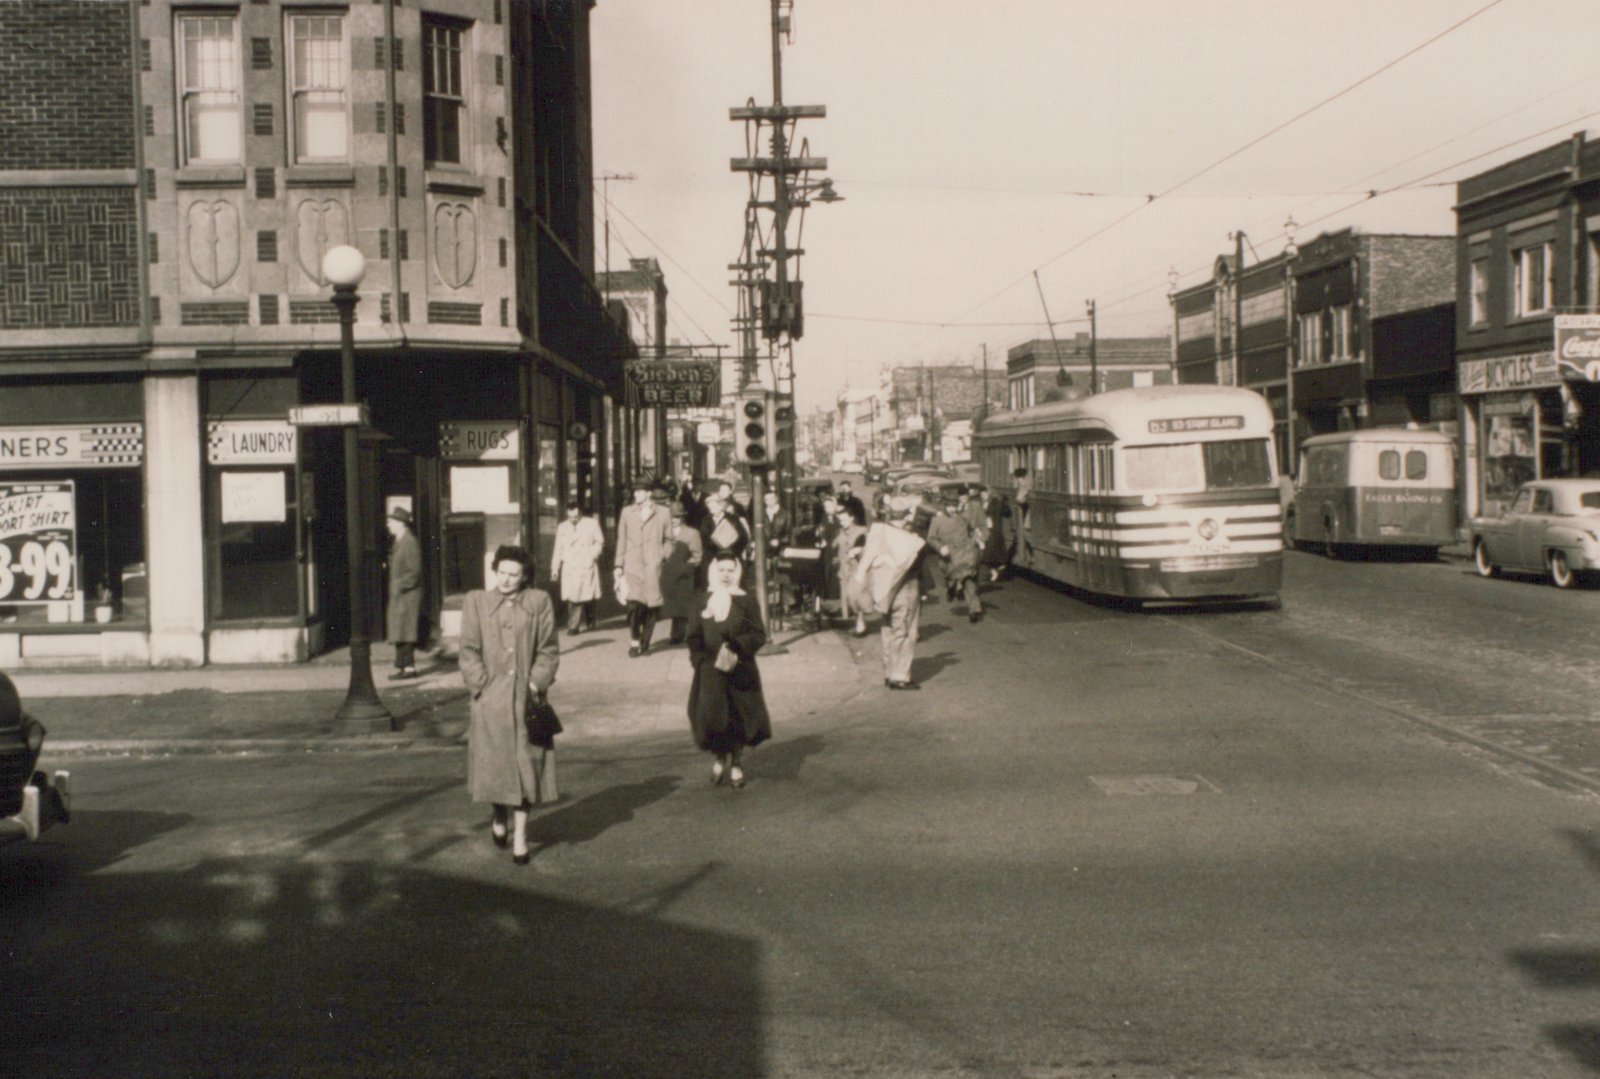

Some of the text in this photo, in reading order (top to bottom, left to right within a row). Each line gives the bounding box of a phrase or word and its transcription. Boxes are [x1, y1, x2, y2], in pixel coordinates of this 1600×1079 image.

[629, 362, 714, 384] Sieben's
[644, 390, 702, 403] BEER
[1, 436, 69, 457] NERS
[231, 431, 294, 454] LAUNDRY
[467, 430, 510, 450] RUGS
[0, 511, 69, 533] ORT SHIRT
